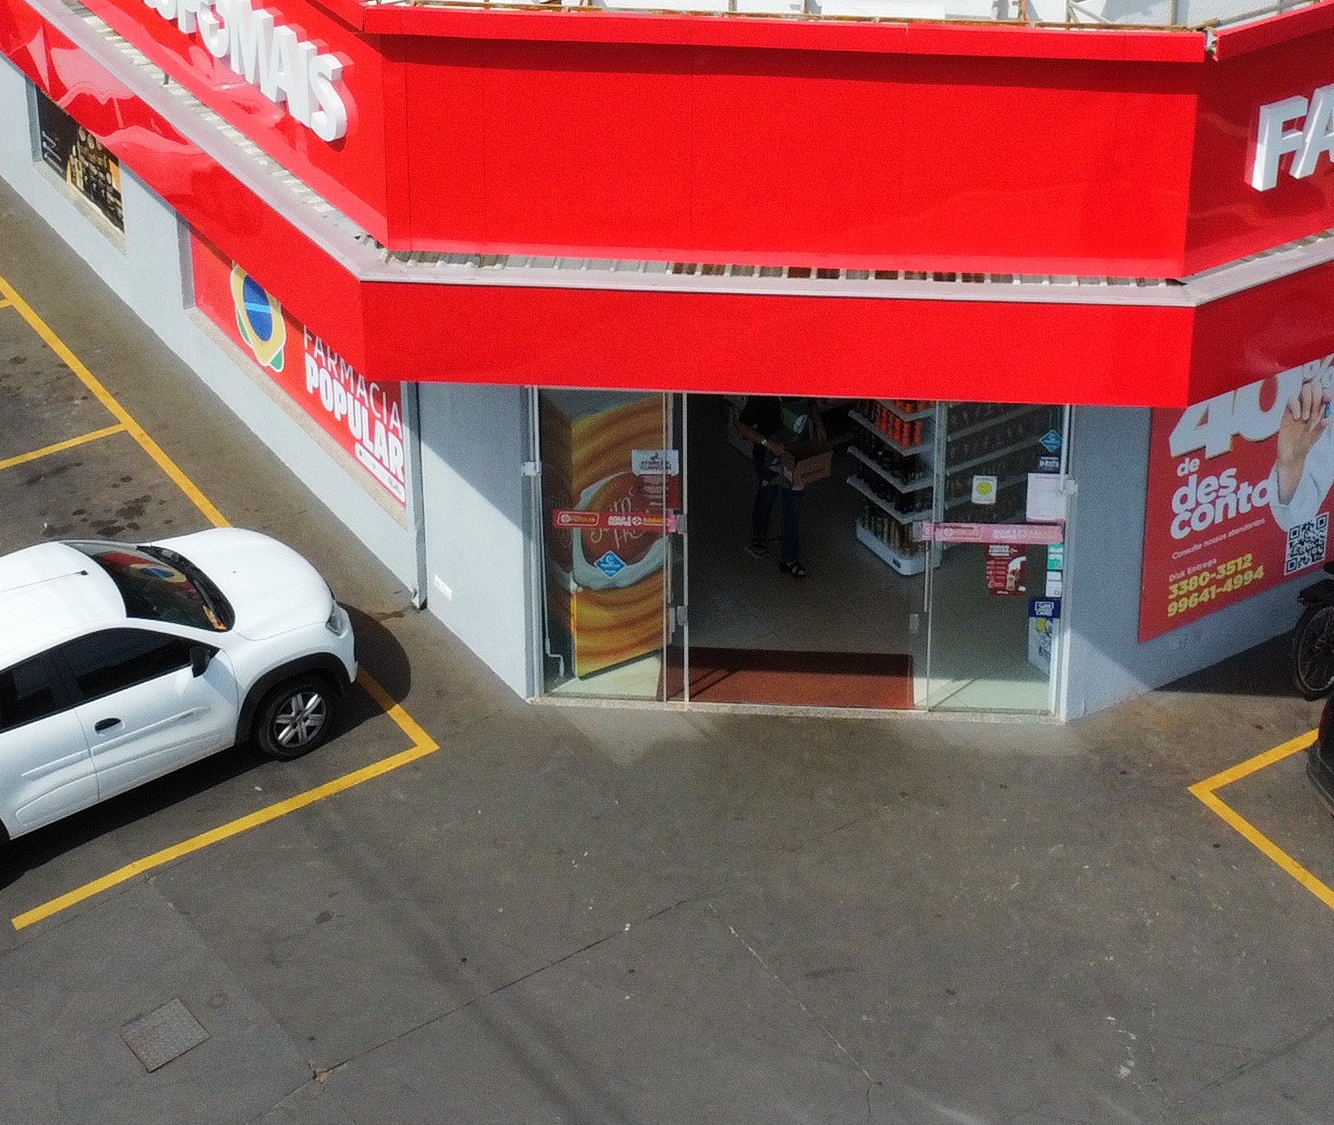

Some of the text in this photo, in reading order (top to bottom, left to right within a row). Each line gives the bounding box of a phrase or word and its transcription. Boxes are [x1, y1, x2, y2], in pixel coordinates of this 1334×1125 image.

[304, 351, 406, 484] POPULAR
[1171, 467, 1238, 514] des
[1176, 457, 1201, 477] de
[1170, 479, 1271, 540] conto
[1168, 553, 1253, 599] 3380-3512
[1187, 558, 1217, 574] Entrega
[1167, 565, 1265, 617] 99641-4994
